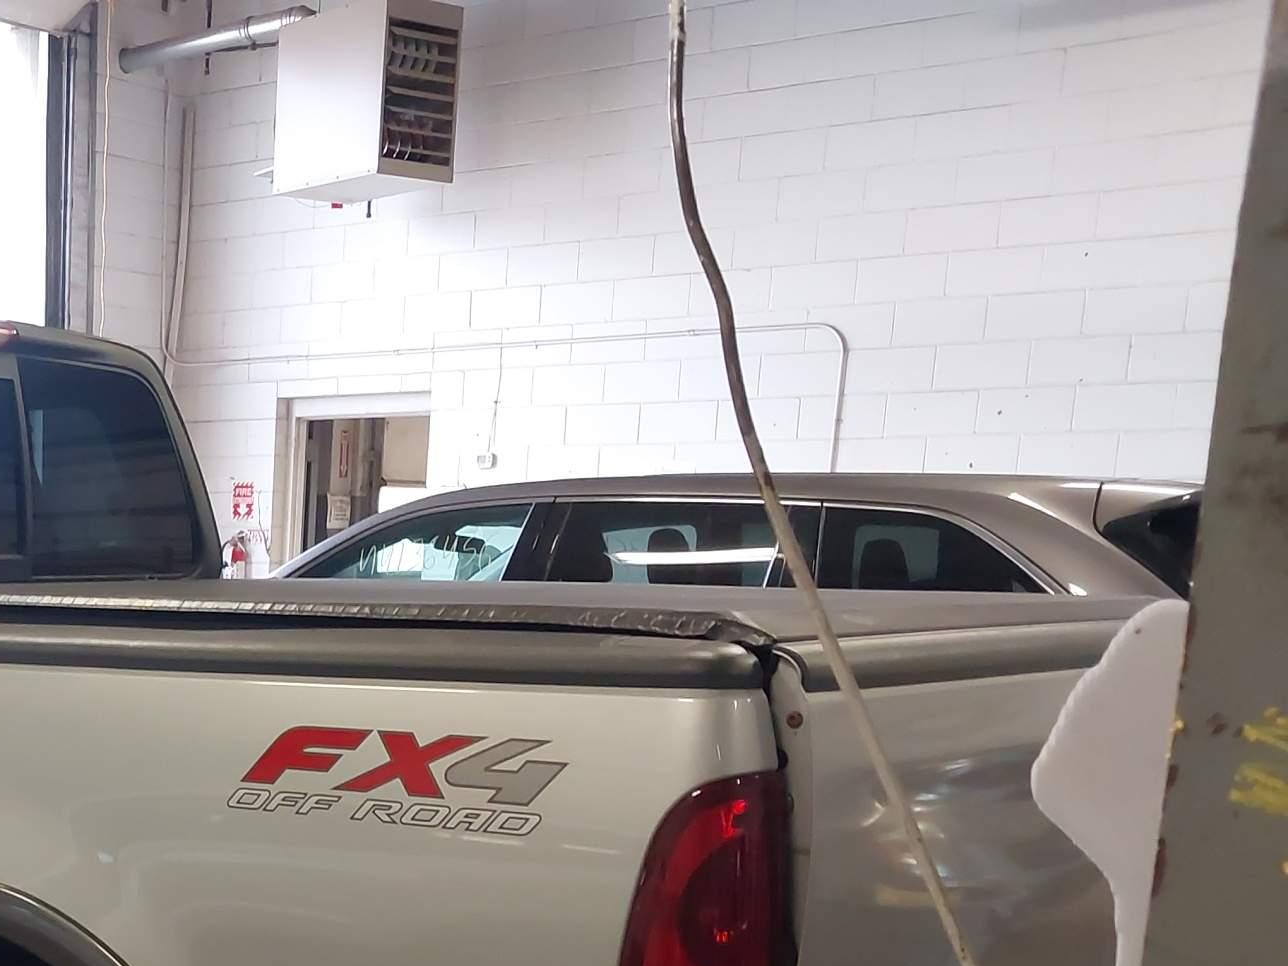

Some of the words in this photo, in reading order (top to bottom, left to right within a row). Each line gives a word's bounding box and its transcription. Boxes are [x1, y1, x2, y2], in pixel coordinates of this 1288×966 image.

[235, 487, 252, 497] FIRE
[240, 725, 569, 807] FX4
[226, 787, 343, 815] OFF
[350, 798, 542, 836] ROAD
